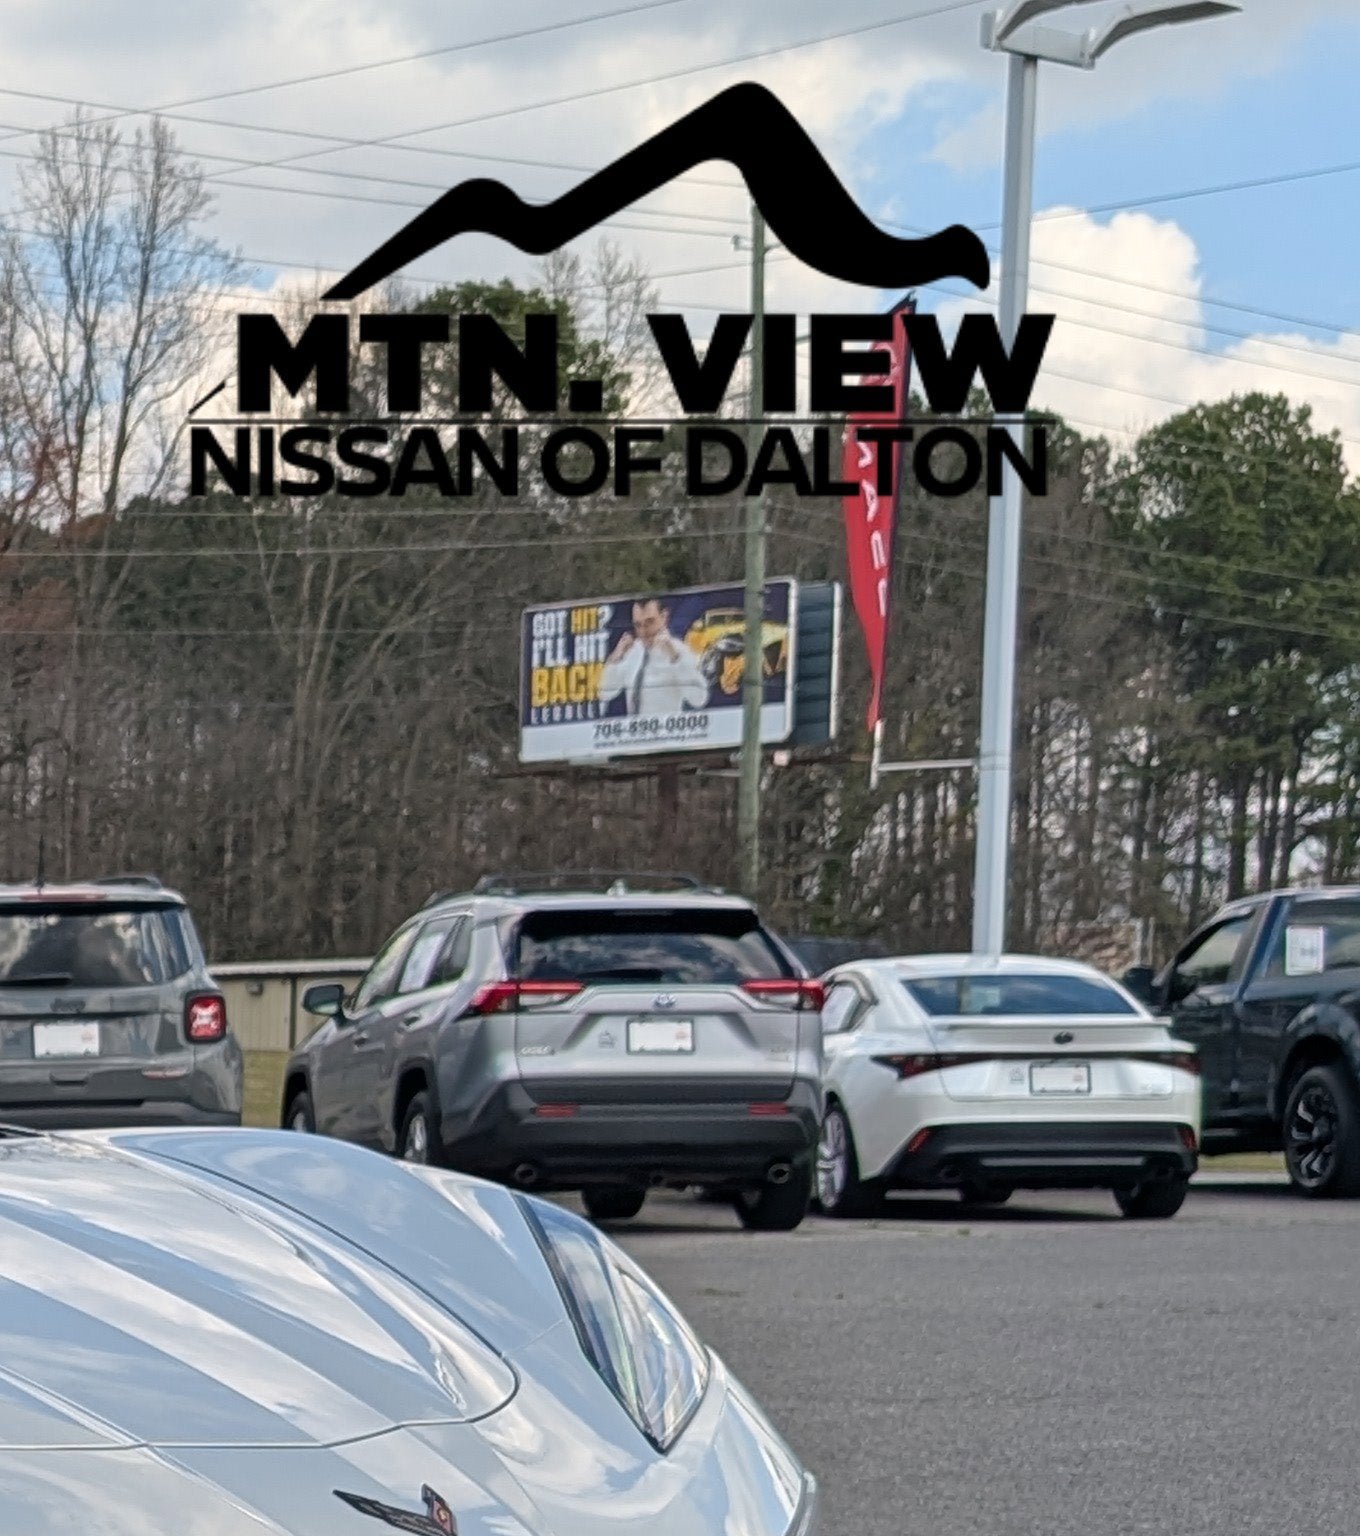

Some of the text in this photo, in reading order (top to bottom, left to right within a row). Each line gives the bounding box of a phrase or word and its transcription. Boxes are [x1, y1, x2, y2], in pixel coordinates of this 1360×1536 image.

[532, 604, 614, 638] GOT HIT?
[573, 632, 610, 664] HIT
[530, 662, 603, 708] BACK
